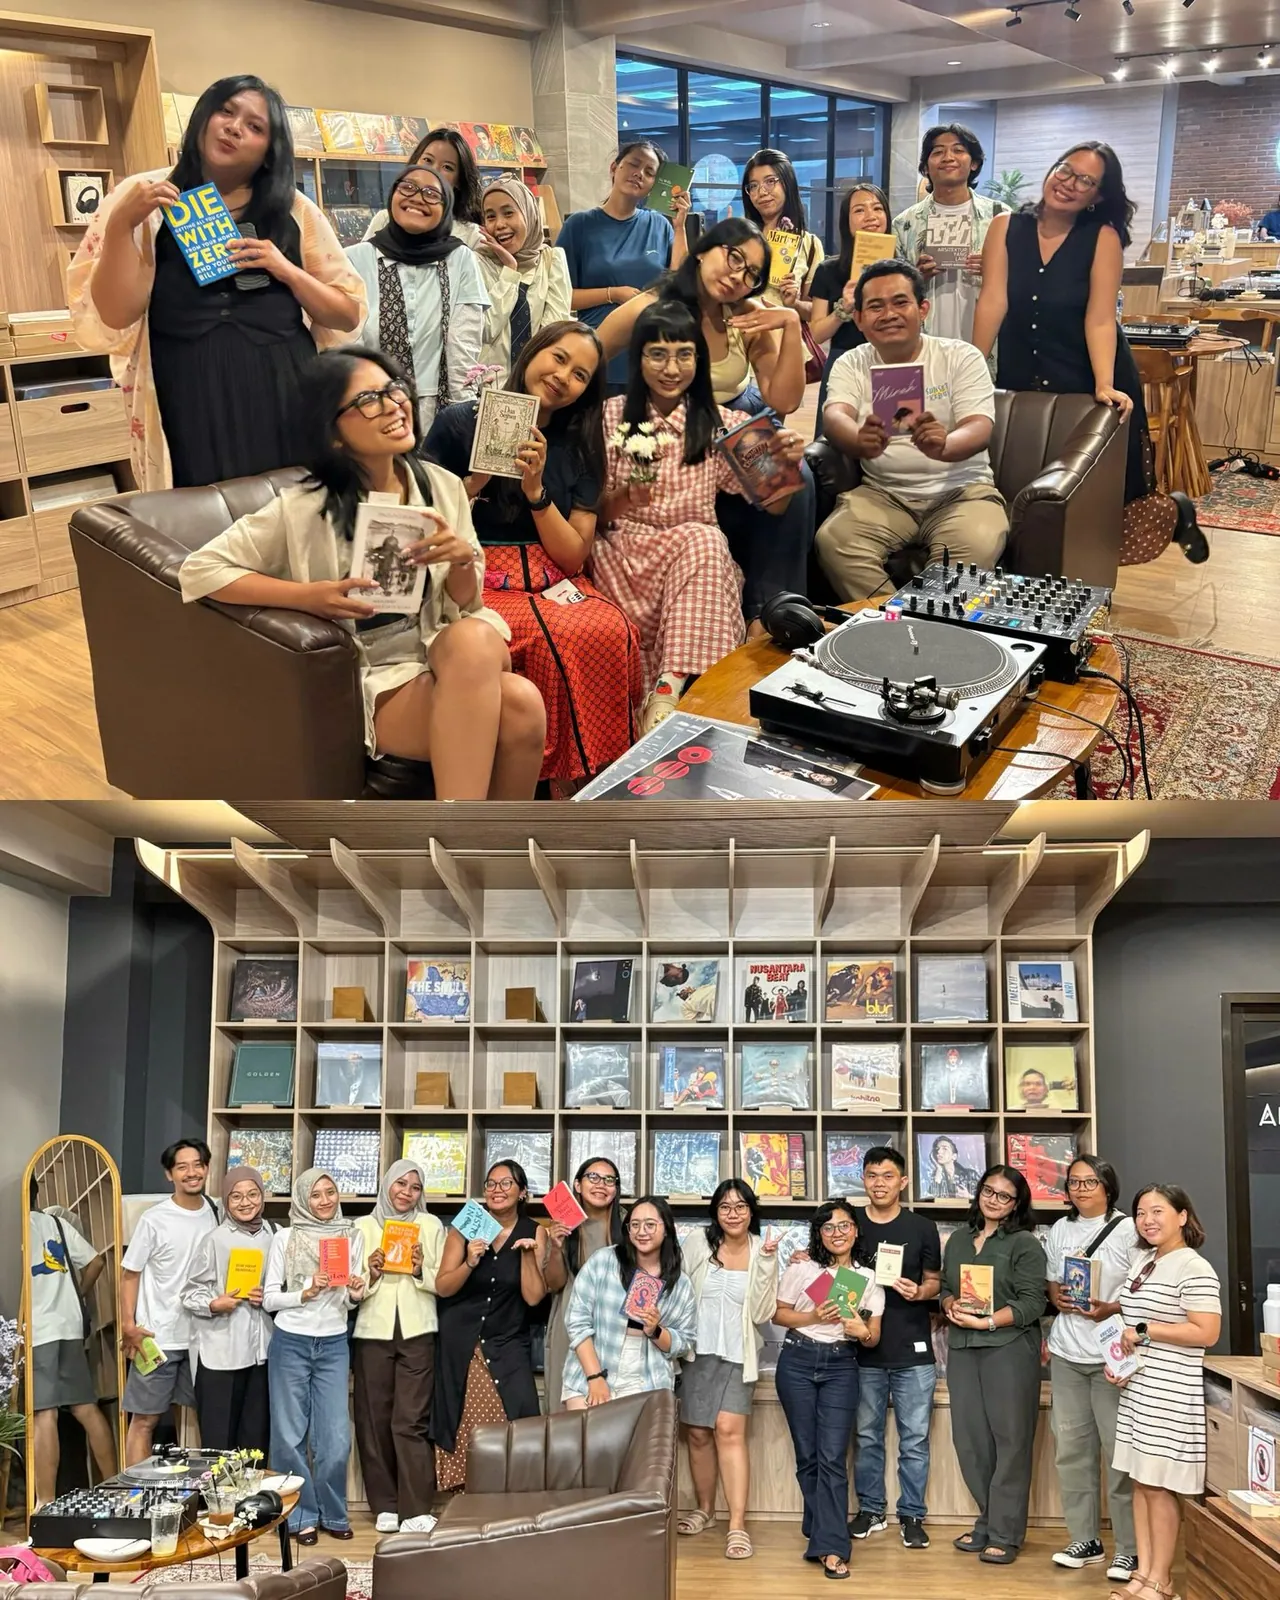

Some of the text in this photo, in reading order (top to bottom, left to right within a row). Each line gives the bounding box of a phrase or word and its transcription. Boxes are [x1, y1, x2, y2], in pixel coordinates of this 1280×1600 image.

[162, 187, 224, 228] DIE
[177, 216, 235, 248] WITH
[769, 230, 799, 248] Martr!
[185, 232, 237, 254] FROM YOUR MONEY
[196, 264, 212, 275] AND
[199, 270, 216, 281] BILL
[750, 963, 806, 974] NUSANTARA
[766, 972, 790, 982] BEAT
[410, 981, 432, 993] THE
[1064, 982, 1074, 1000] ANRI
[866, 999, 894, 1014] blur
[1259, 1103, 1280, 1127] A
